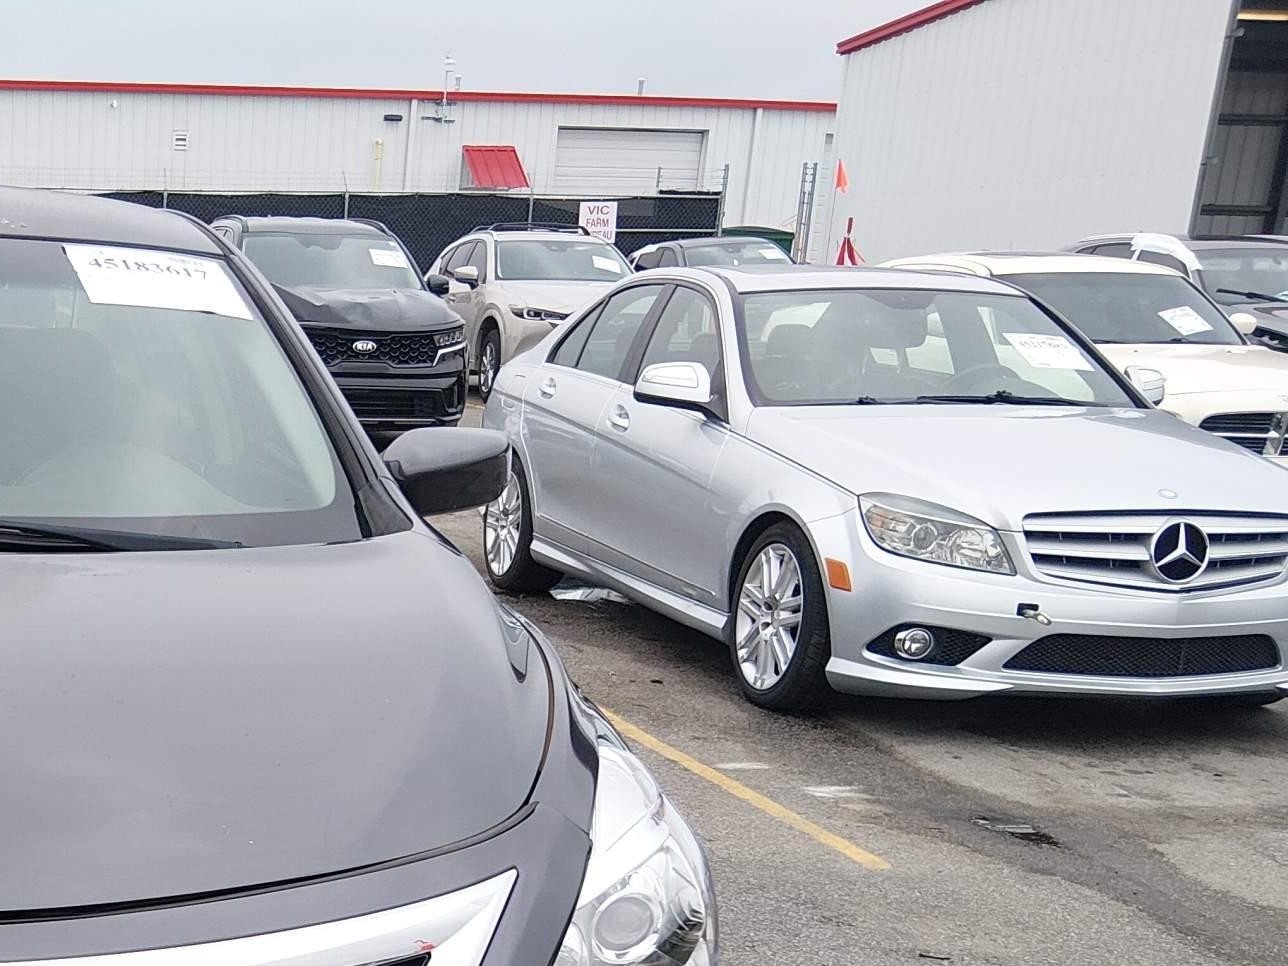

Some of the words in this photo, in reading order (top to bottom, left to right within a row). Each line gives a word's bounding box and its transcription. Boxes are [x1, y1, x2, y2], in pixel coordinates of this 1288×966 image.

[587, 205, 610, 215] VIC
[585, 218, 609, 228] FARM
[88, 258, 207, 280] 45183617
